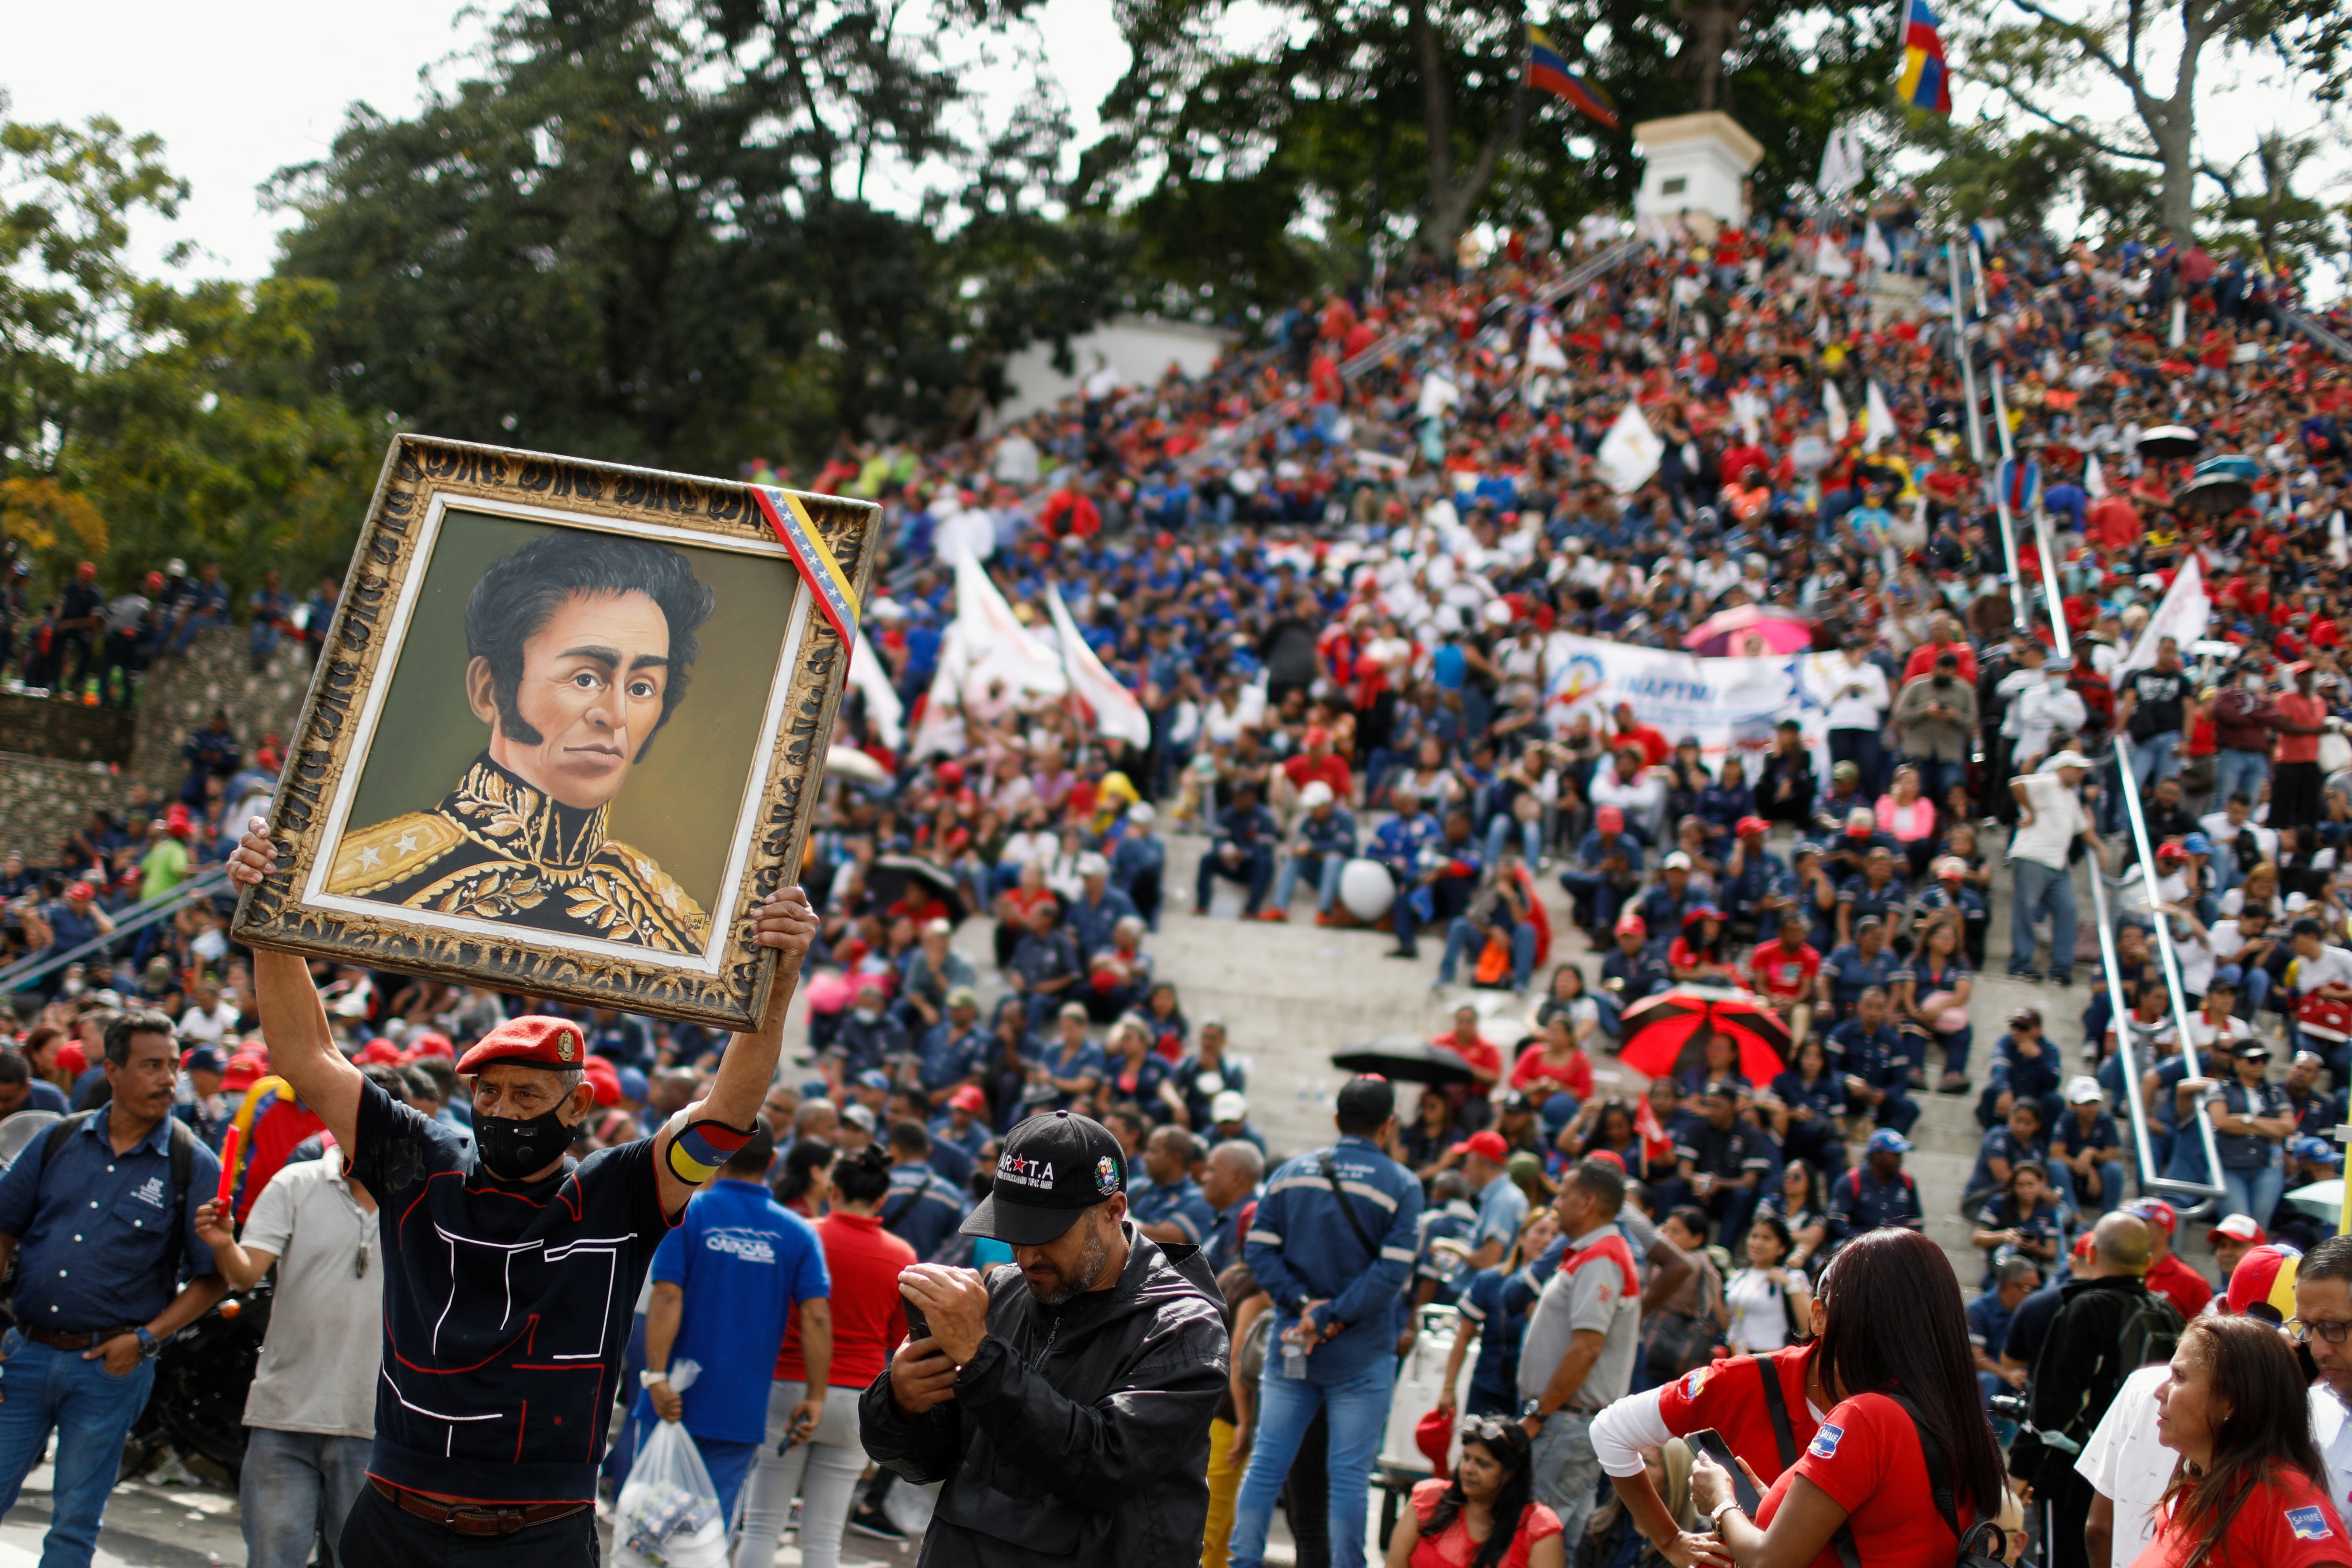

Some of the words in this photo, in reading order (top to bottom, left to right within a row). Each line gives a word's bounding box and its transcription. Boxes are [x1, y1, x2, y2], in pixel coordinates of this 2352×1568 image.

[1028, 1178, 1040, 1187] TUPAC
[1040, 1180, 1053, 1190] AMARU
[706, 1236, 774, 1258] CARACAS
[1820, 1429, 1839, 1442] SAIME
[2292, 1513, 2321, 1525] SAIME
